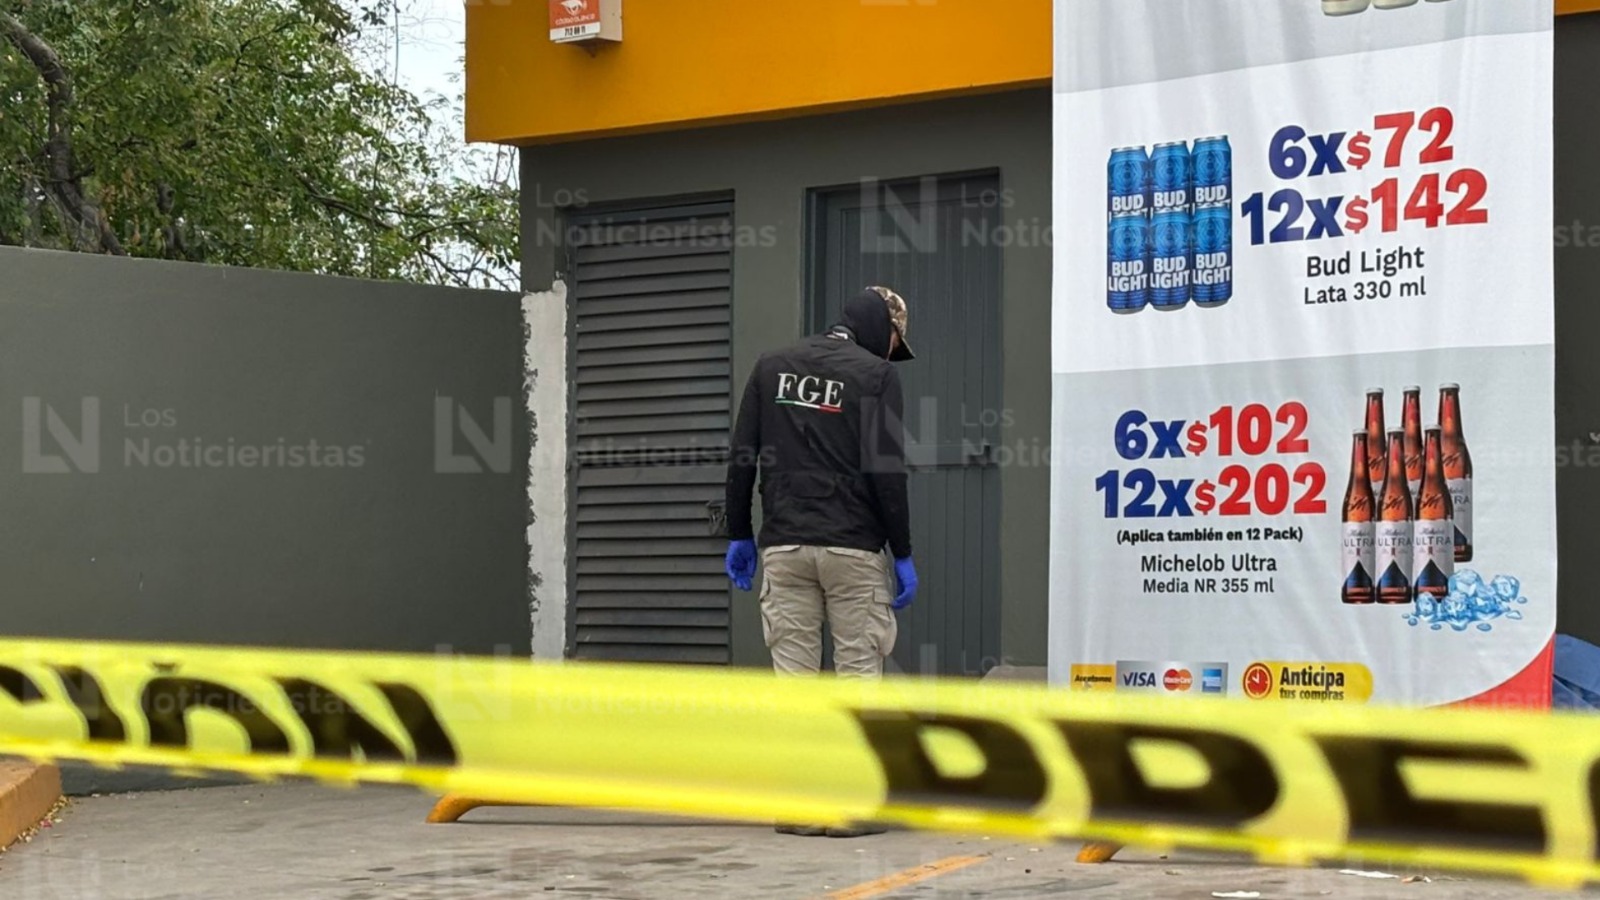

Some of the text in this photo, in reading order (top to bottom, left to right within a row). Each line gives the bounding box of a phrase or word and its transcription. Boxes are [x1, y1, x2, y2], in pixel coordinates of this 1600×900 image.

[1112, 194, 1144, 211] BUD
[1153, 190, 1186, 207] BUD
[1195, 185, 1227, 203] BUD
[1112, 260, 1144, 277] BUD
[1153, 256, 1186, 273] BUD
[1196, 252, 1227, 269] BUD
[1307, 246, 1424, 277] Bud Light
[1108, 274, 1148, 292] LIGHT
[1150, 270, 1190, 289] LIGHT
[1192, 266, 1231, 285] LIGHT
[1304, 276, 1426, 304] Lata 330 ml
[775, 373, 844, 408] FGE
[1117, 526, 1303, 545] (Aplica también en 12 Pack)
[1344, 537, 1374, 547] ULTRA
[1378, 537, 1412, 547] ULTRA
[1416, 536, 1451, 546] ULTRA
[1141, 553, 1277, 572] Michelob Ultra
[1143, 577, 1274, 593] Media NR 355 ml
[1123, 671, 1156, 687] VISA
[1280, 665, 1344, 691] Anticipa
[1280, 687, 1344, 702] tus compras
